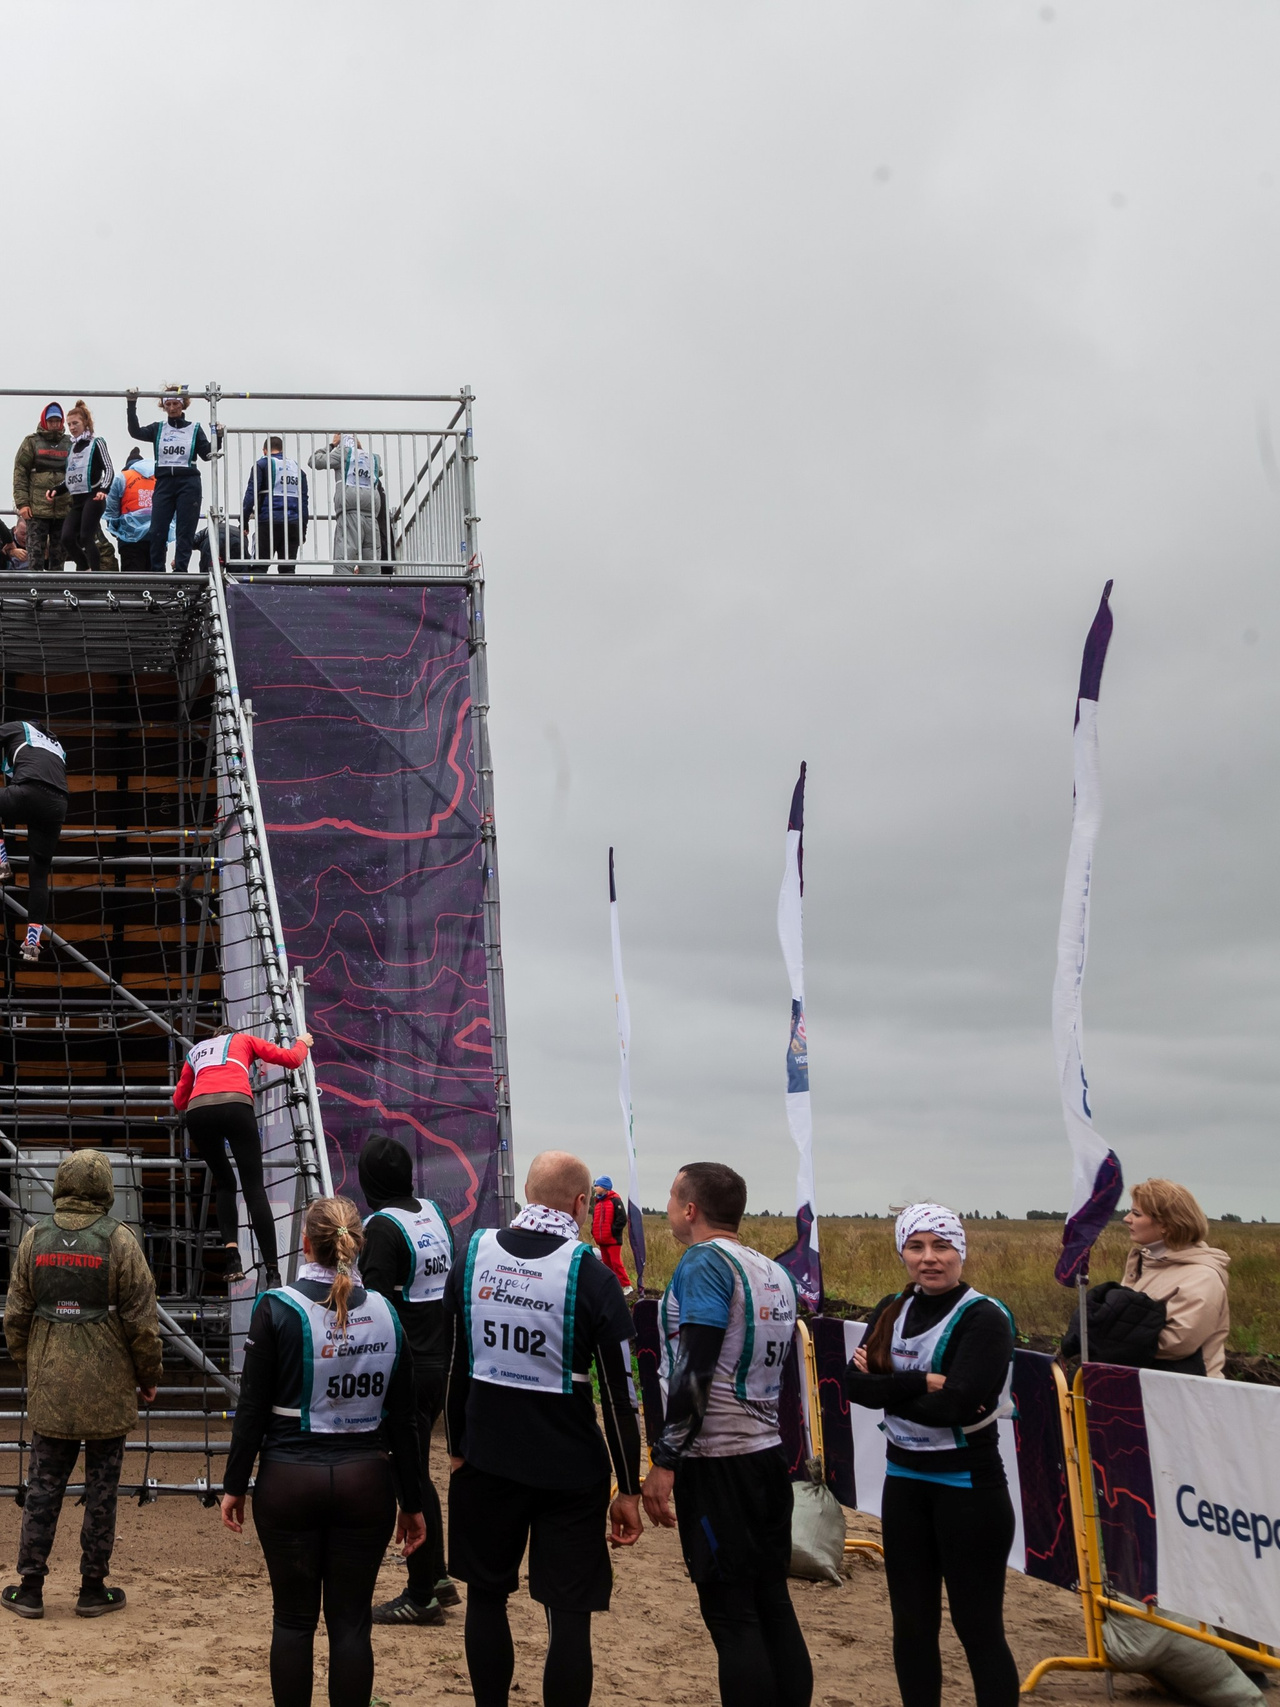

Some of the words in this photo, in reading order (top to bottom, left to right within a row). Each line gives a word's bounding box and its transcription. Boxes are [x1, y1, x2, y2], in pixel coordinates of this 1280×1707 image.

[162, 445, 186, 456] 5046
[417, 1238, 432, 1249] ВСК
[36, 1252, 102, 1270] ИНСТРУКТОР
[424, 1254, 449, 1276] 5062
[496, 1264, 518, 1274] ГОНКА
[518, 1268, 542, 1278] ГЕРОЕВ
[479, 1270, 530, 1292] Андрей
[483, 1320, 546, 1358] 5102
[326, 1371, 384, 1398] 5098
[500, 1370, 540, 1383] ГАЗПРОМБАНК
[344, 1416, 378, 1424] ГАЗПРОМБАНК
